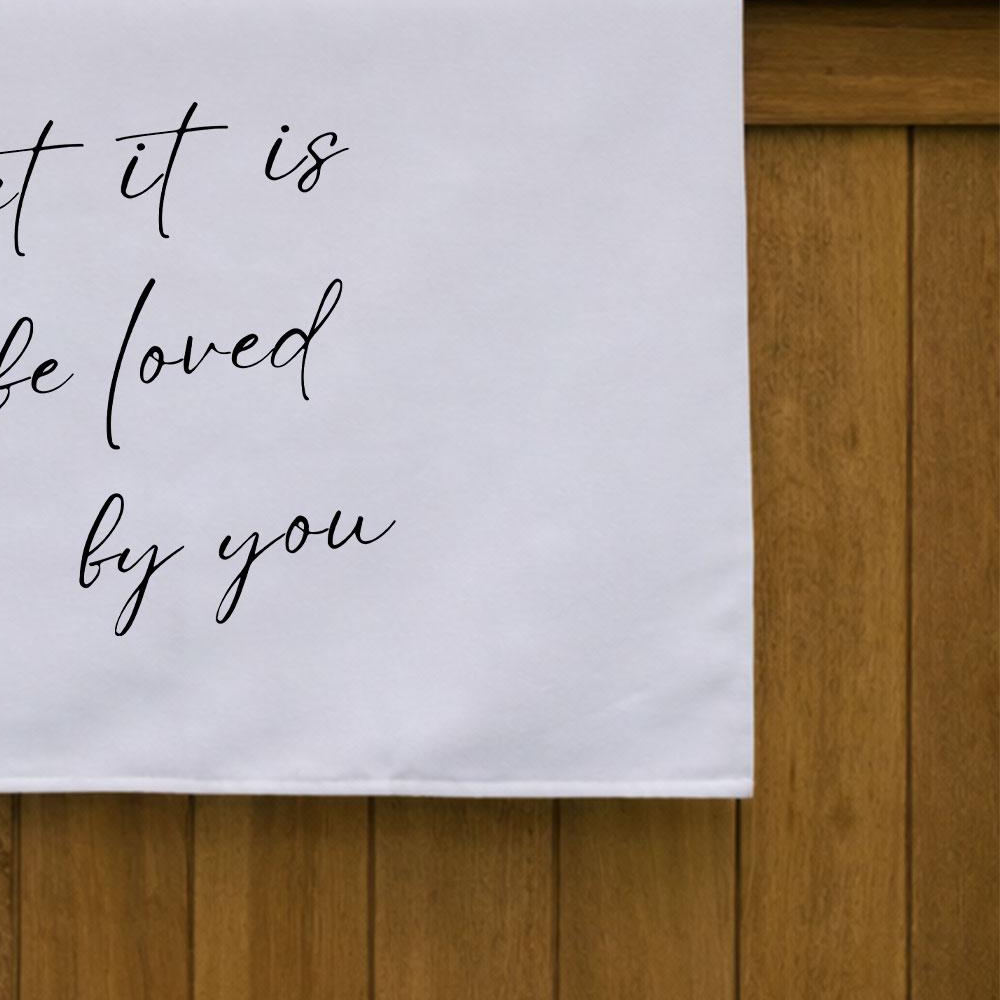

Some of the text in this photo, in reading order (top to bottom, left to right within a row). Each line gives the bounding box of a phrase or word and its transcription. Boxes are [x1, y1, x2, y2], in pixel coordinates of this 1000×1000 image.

[114, 101, 229, 239] it
[264, 124, 350, 194] is
[105, 277, 344, 451] loved
[78, 492, 397, 637] by you
